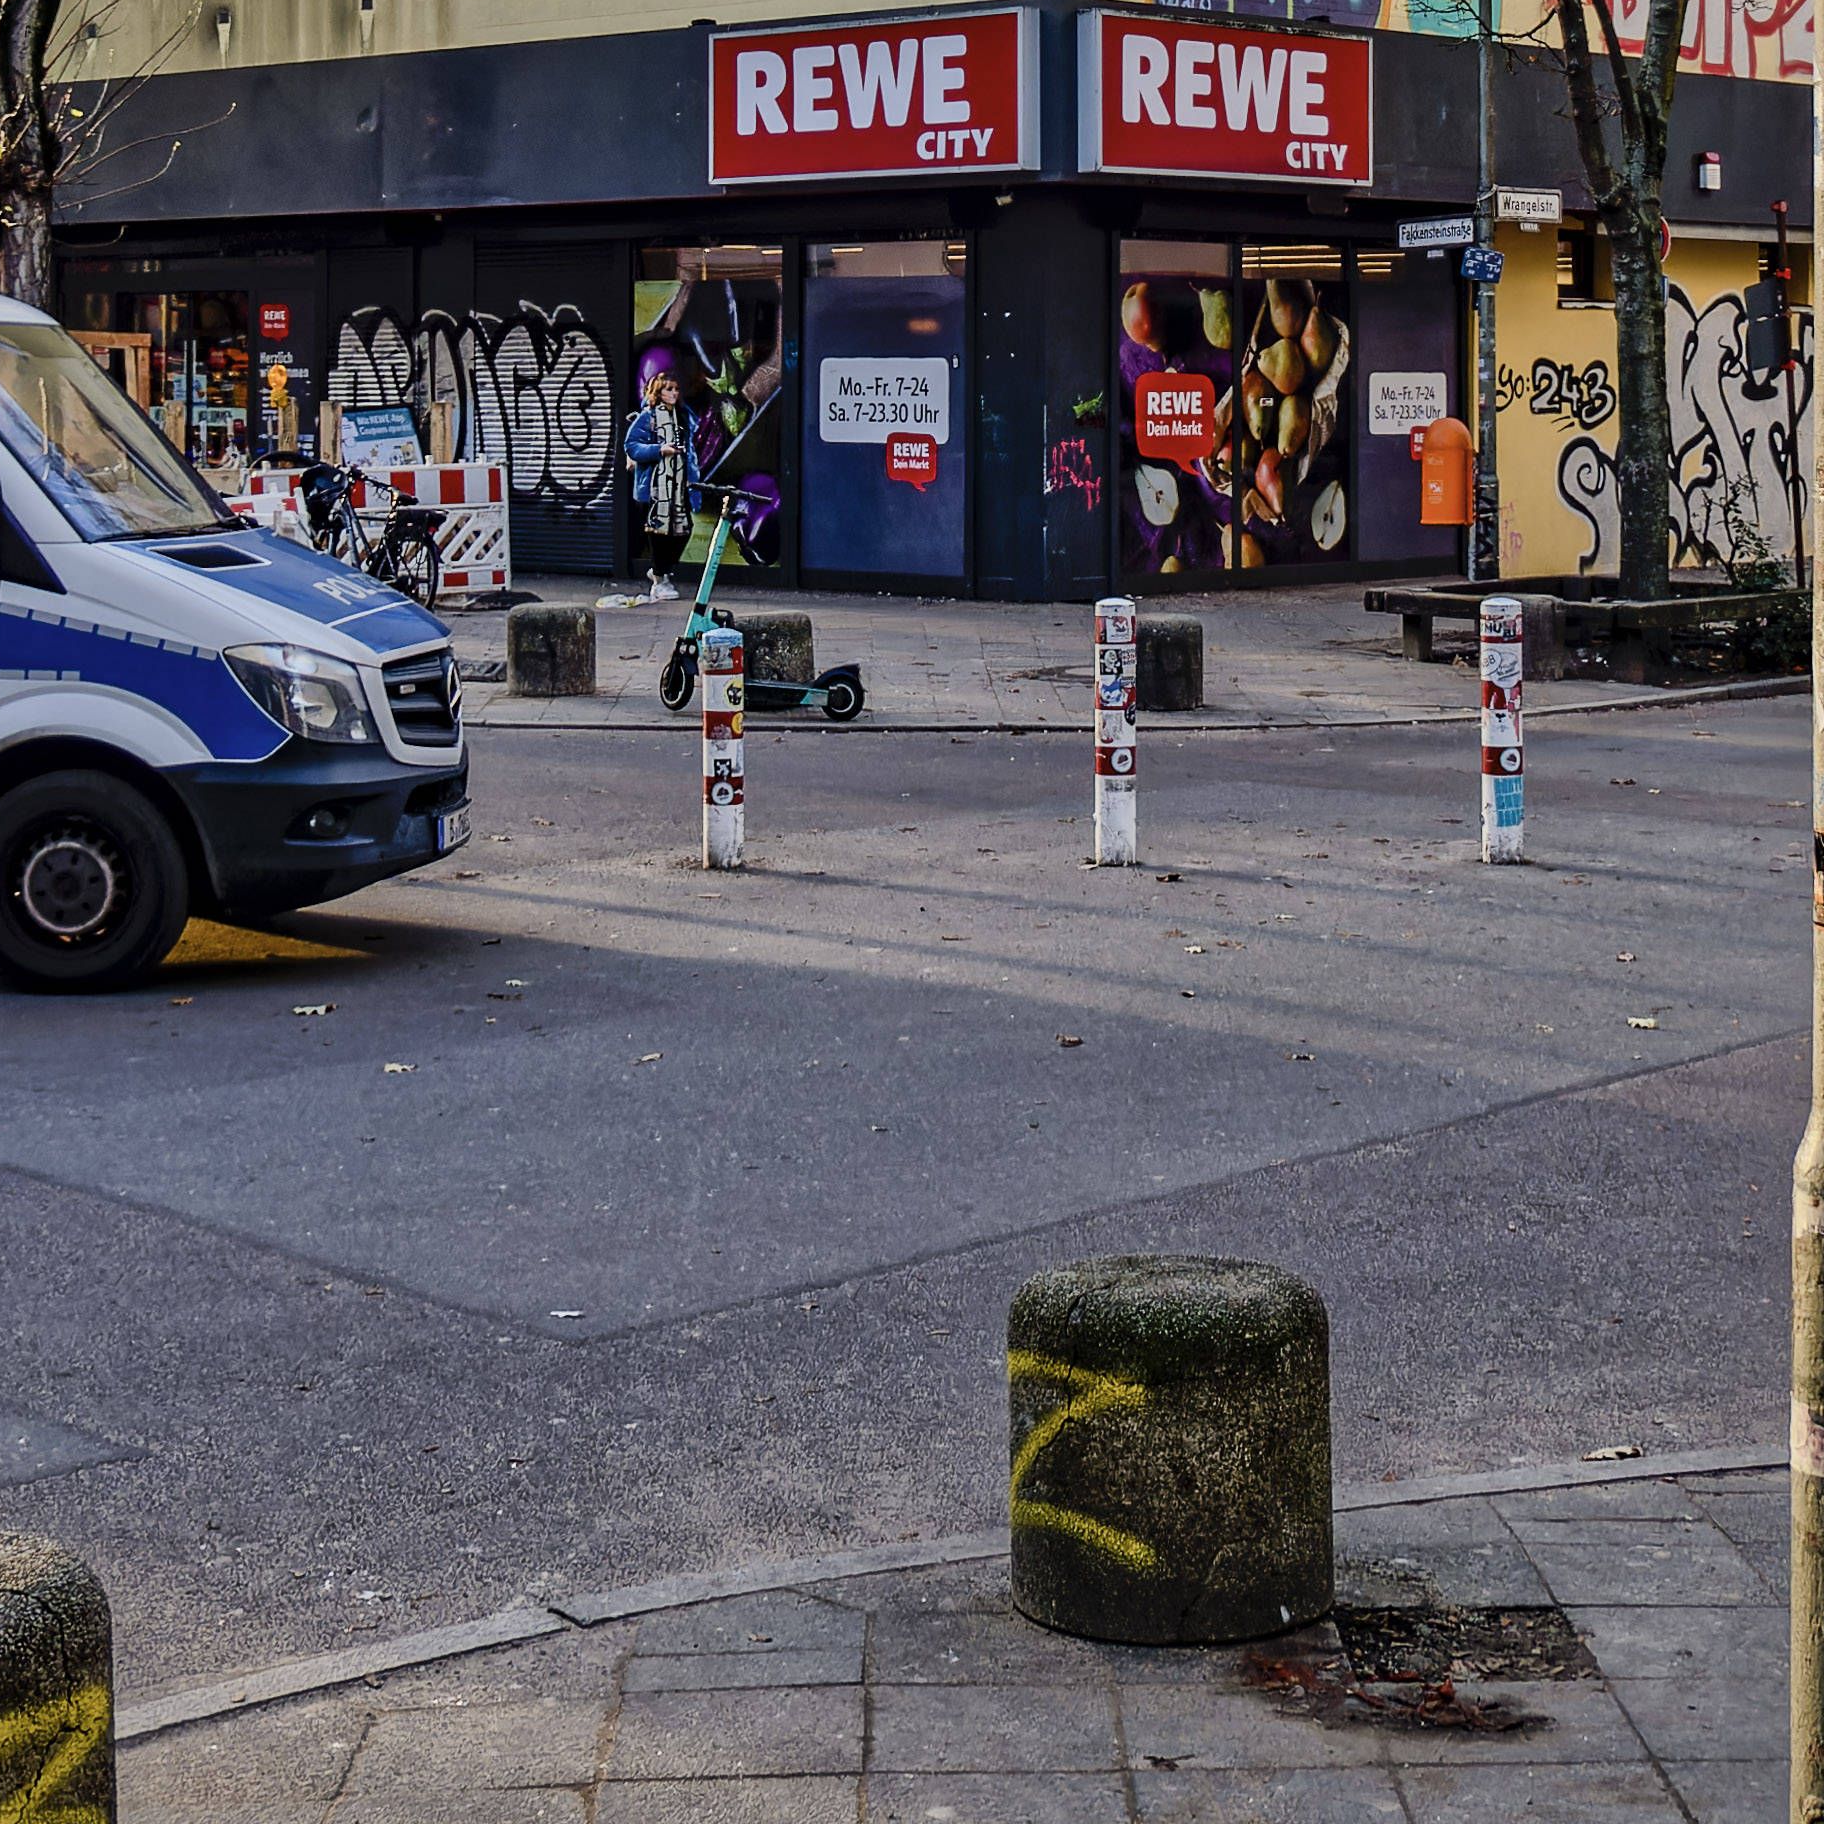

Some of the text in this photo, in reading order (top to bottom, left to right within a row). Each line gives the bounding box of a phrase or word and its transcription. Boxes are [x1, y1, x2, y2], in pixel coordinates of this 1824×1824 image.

[735, 34, 971, 136] REWE
[1121, 33, 1330, 138] REWE
[915, 127, 994, 161] CITY
[1285, 139, 1349, 172] CITY
[1502, 195, 1556, 215] Wrangelstr.
[838, 376, 929, 397] Mo.-Fr. 7-24
[1415, 386, 1435, 401] 7-24
[828, 401, 940, 423] Sa. 7-23.30 Uhr
[1147, 391, 1203, 415] REWE
[1375, 405, 1389, 420] Sa.
[1426, 405, 1441, 420] Uhr
[1146, 420, 1203, 437] Dein Markt
[893, 442, 929, 457] REWE
[893, 458, 929, 470] Dein Markt
